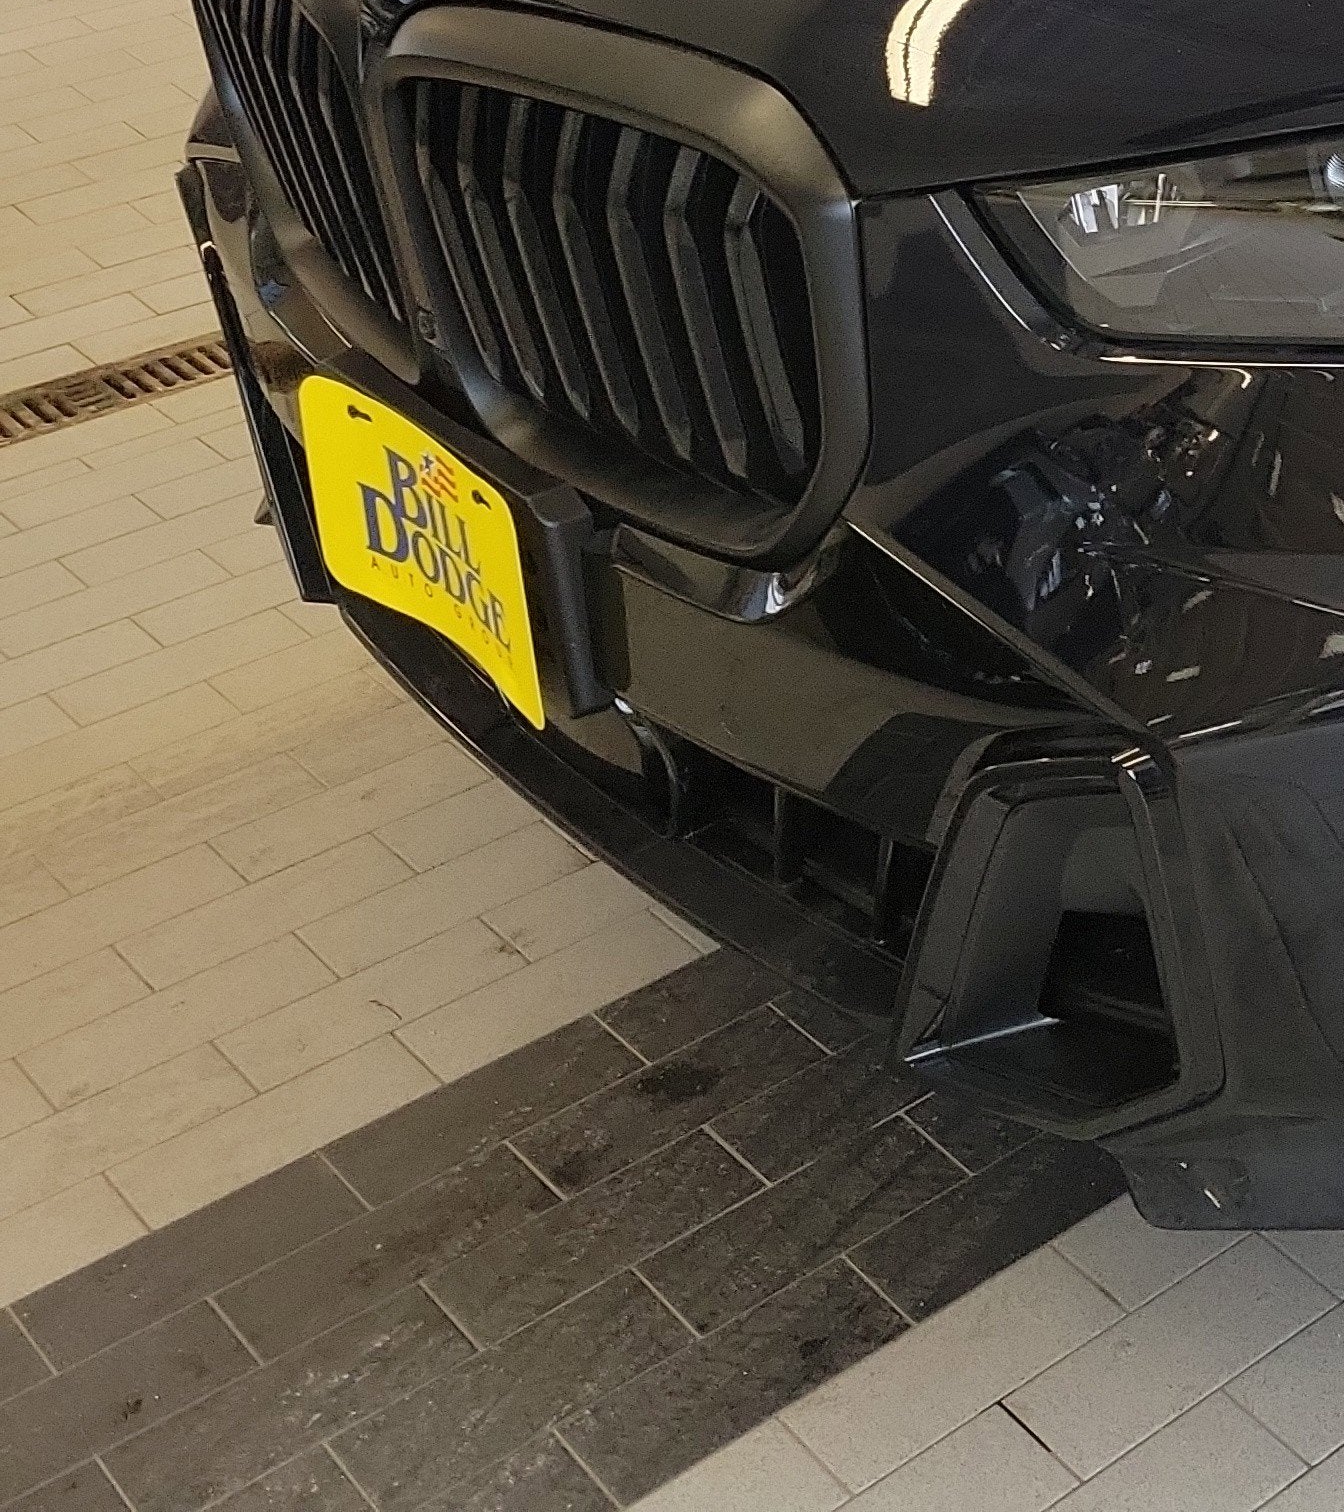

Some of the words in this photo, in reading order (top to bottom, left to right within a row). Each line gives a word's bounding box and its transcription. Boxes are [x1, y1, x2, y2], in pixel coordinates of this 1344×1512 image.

[356, 480, 512, 655] DODGE
[371, 556, 434, 598] AUTO
[382, 445, 482, 577] BILL
